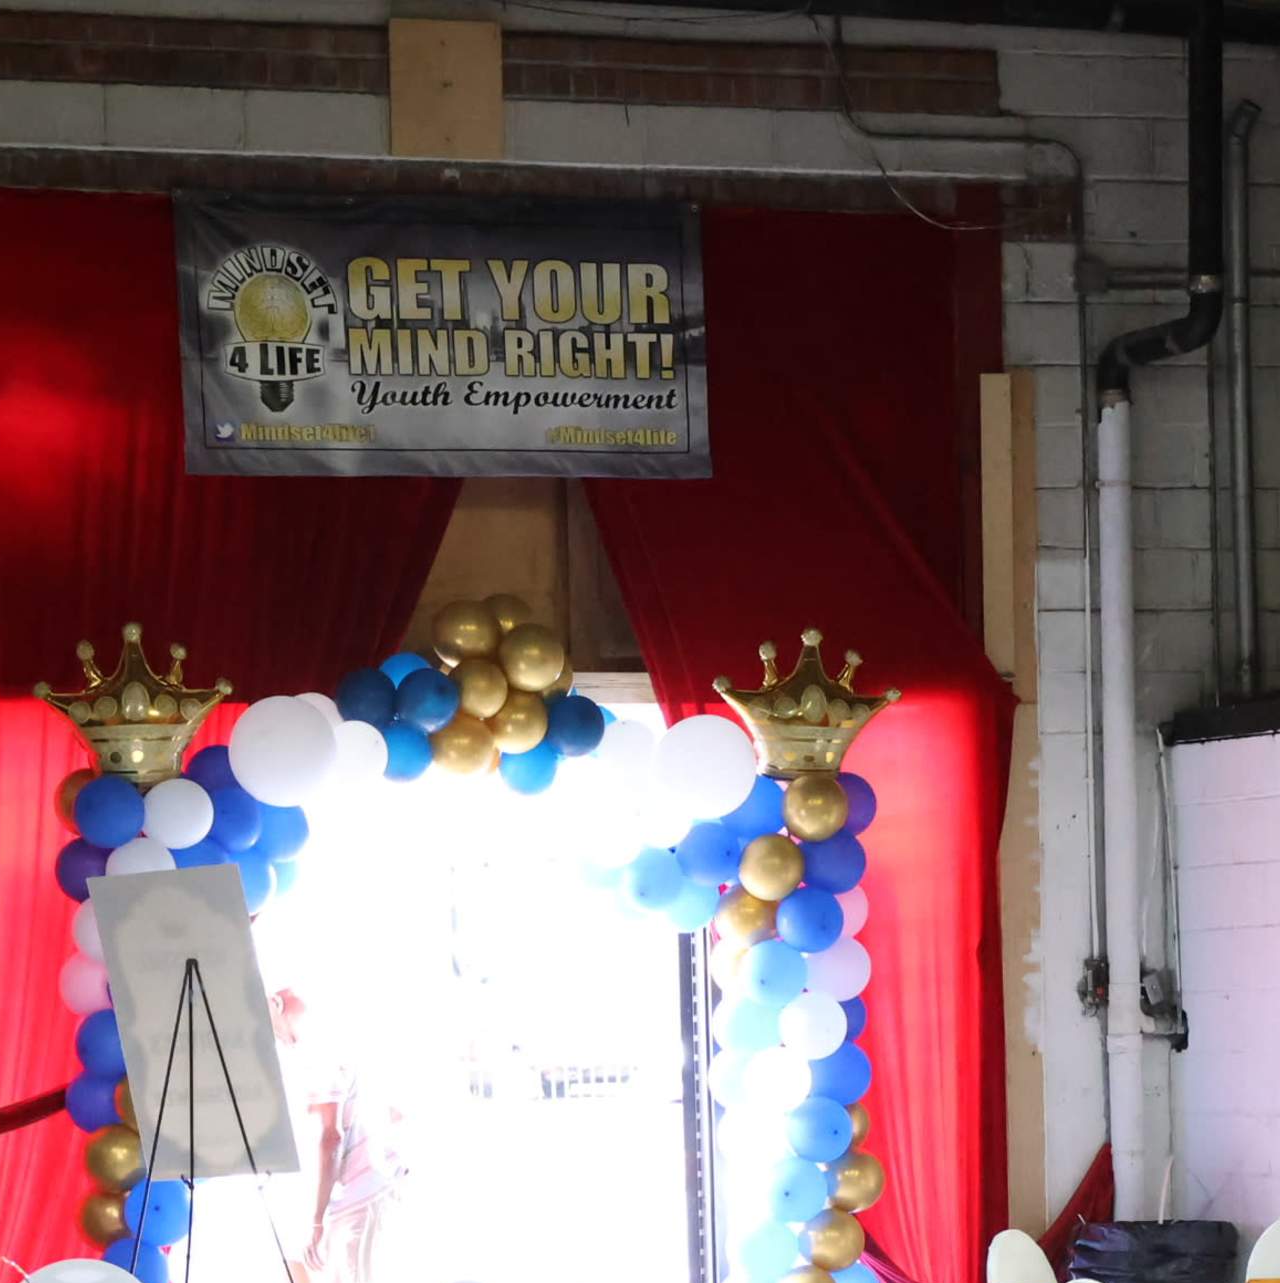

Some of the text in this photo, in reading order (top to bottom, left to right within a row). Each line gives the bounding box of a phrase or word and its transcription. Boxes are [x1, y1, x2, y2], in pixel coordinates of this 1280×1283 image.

[206, 246, 338, 316] MINDSET
[346, 256, 672, 326] GET YOUR
[228, 342, 322, 377] 4 LIFE
[346, 326, 676, 380] MIND RIGHT!
[350, 380, 677, 415] Youth Empowerment
